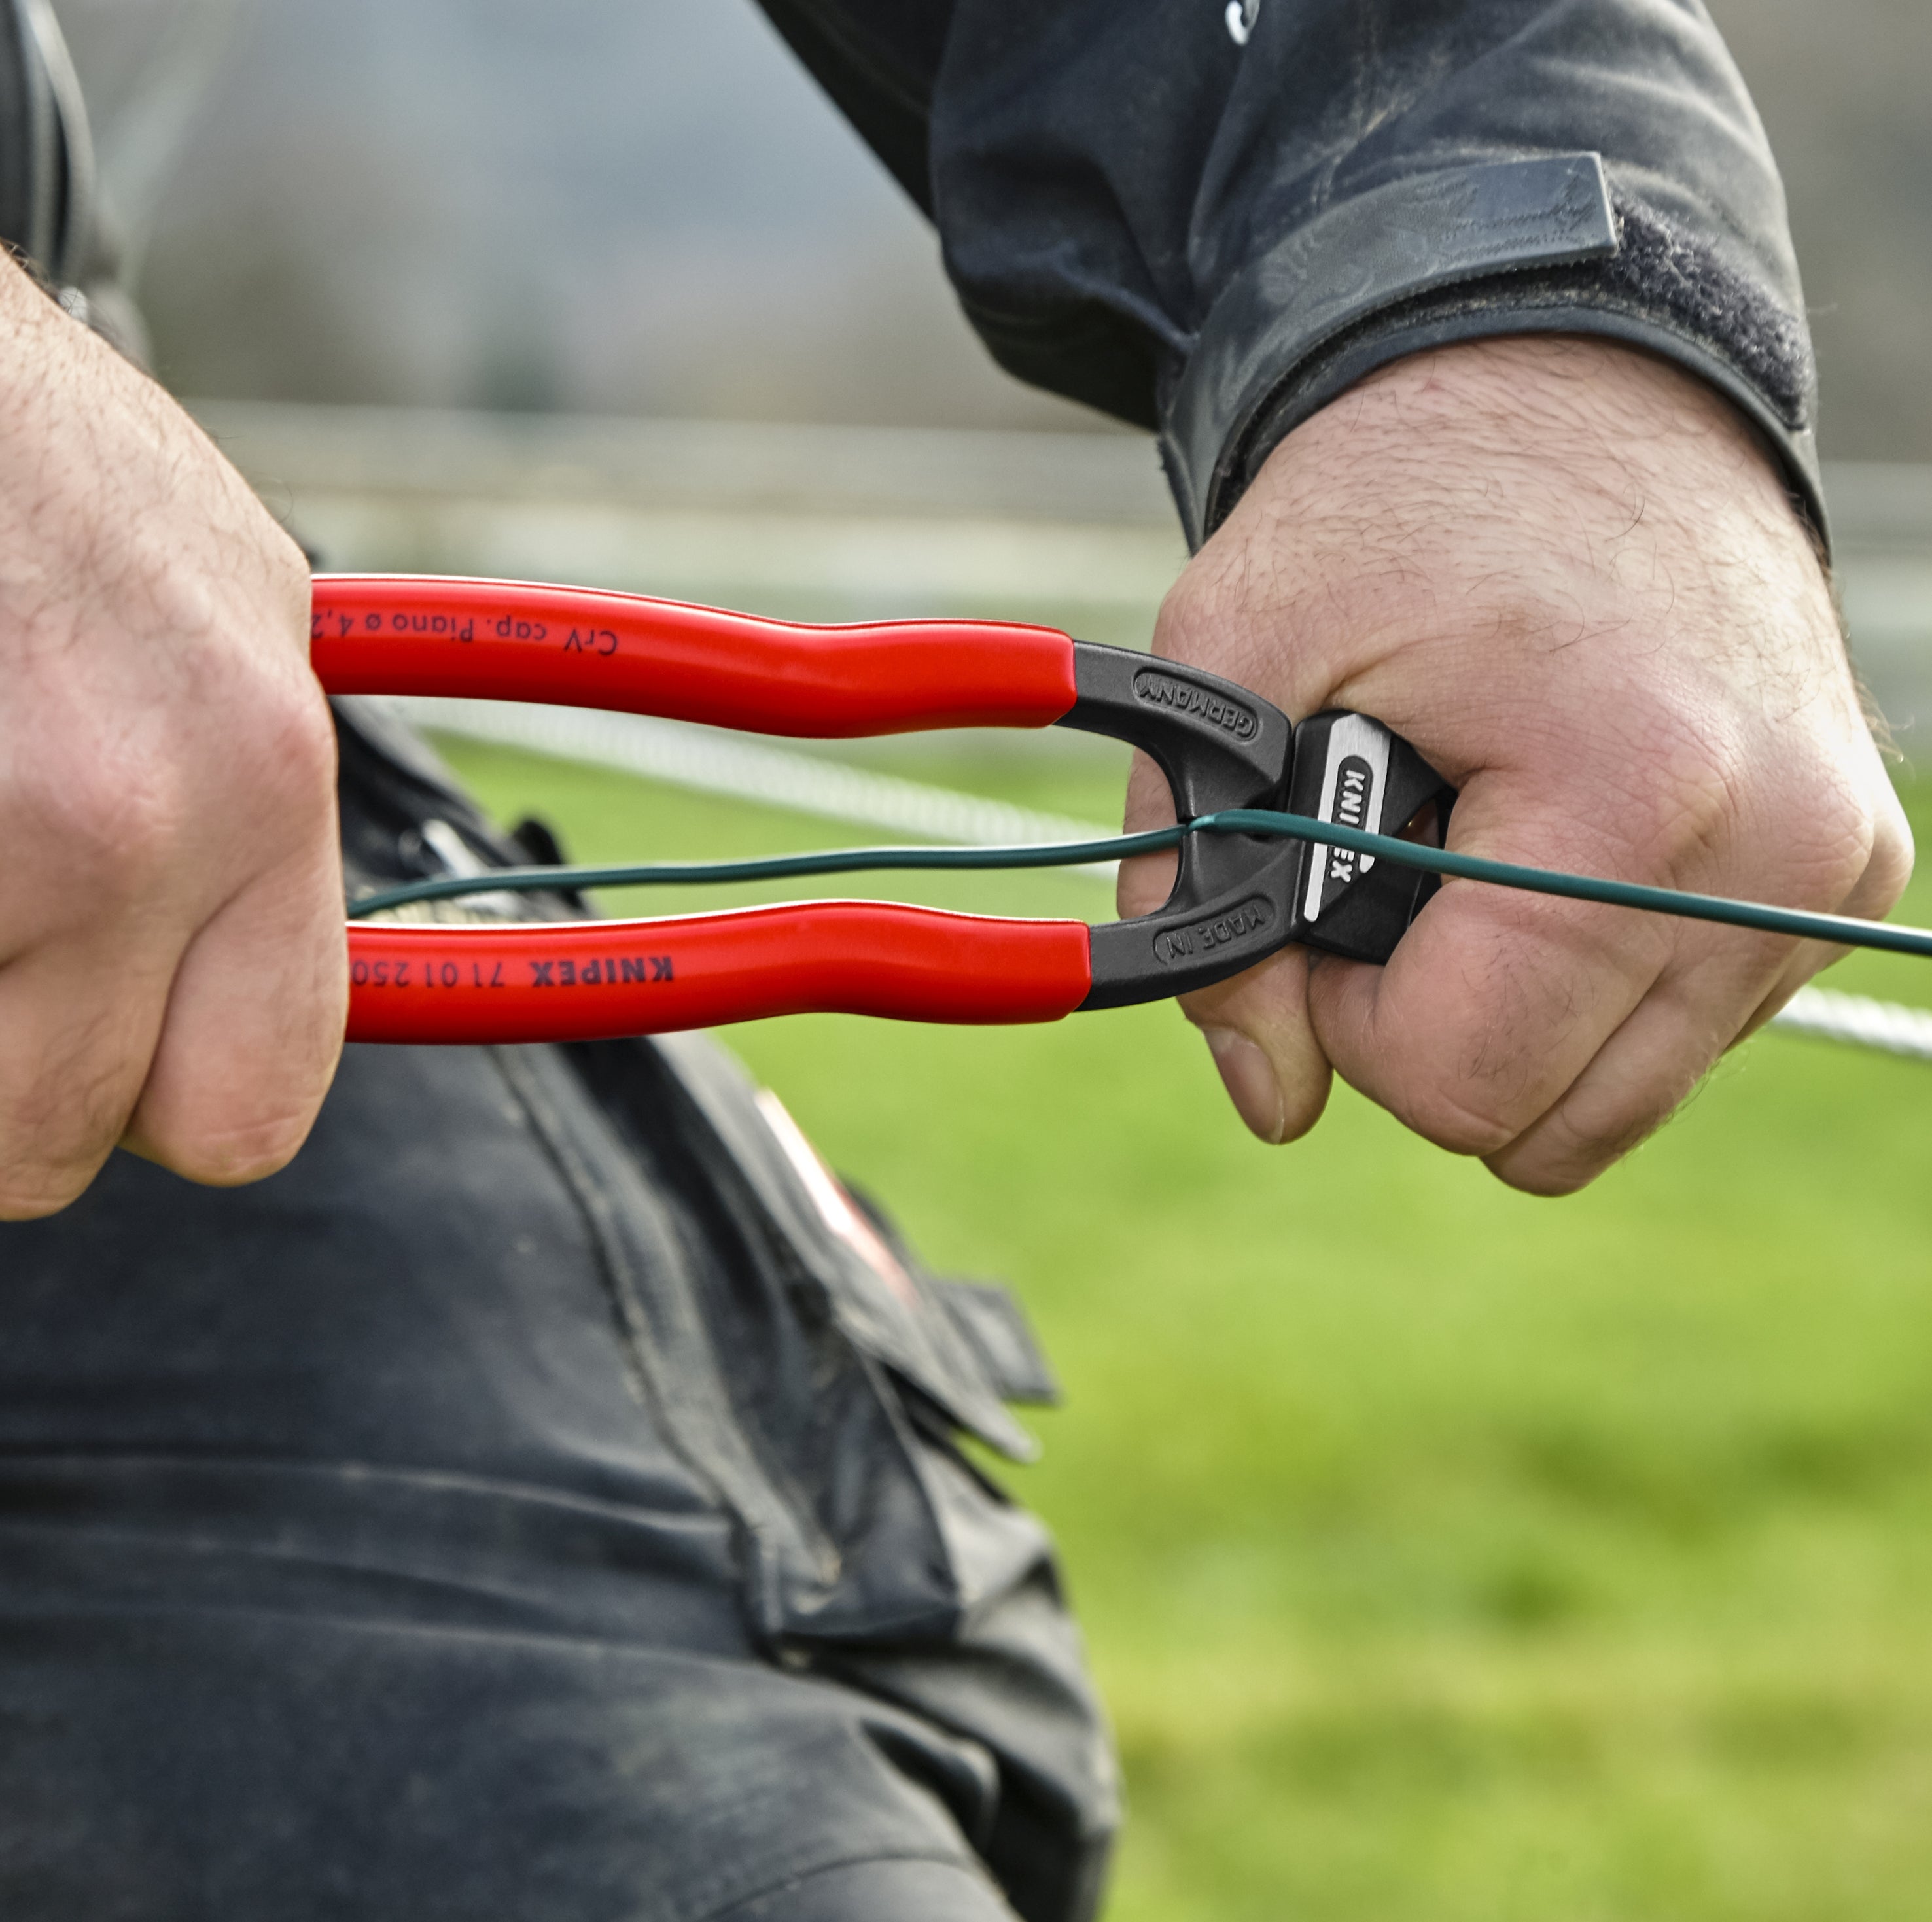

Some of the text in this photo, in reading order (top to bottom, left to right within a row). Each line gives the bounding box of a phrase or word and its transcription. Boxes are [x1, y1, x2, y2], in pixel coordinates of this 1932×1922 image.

[392, 613, 474, 643] Piano
[486, 614, 548, 641] cap.
[563, 628, 618, 656] CrV
[1140, 675, 1254, 738] GERMANY
[1330, 769, 1366, 883] KNIEX
[1166, 905, 1265, 959] MADE IN
[352, 956, 674, 988] KNIPEX 71 01 250
